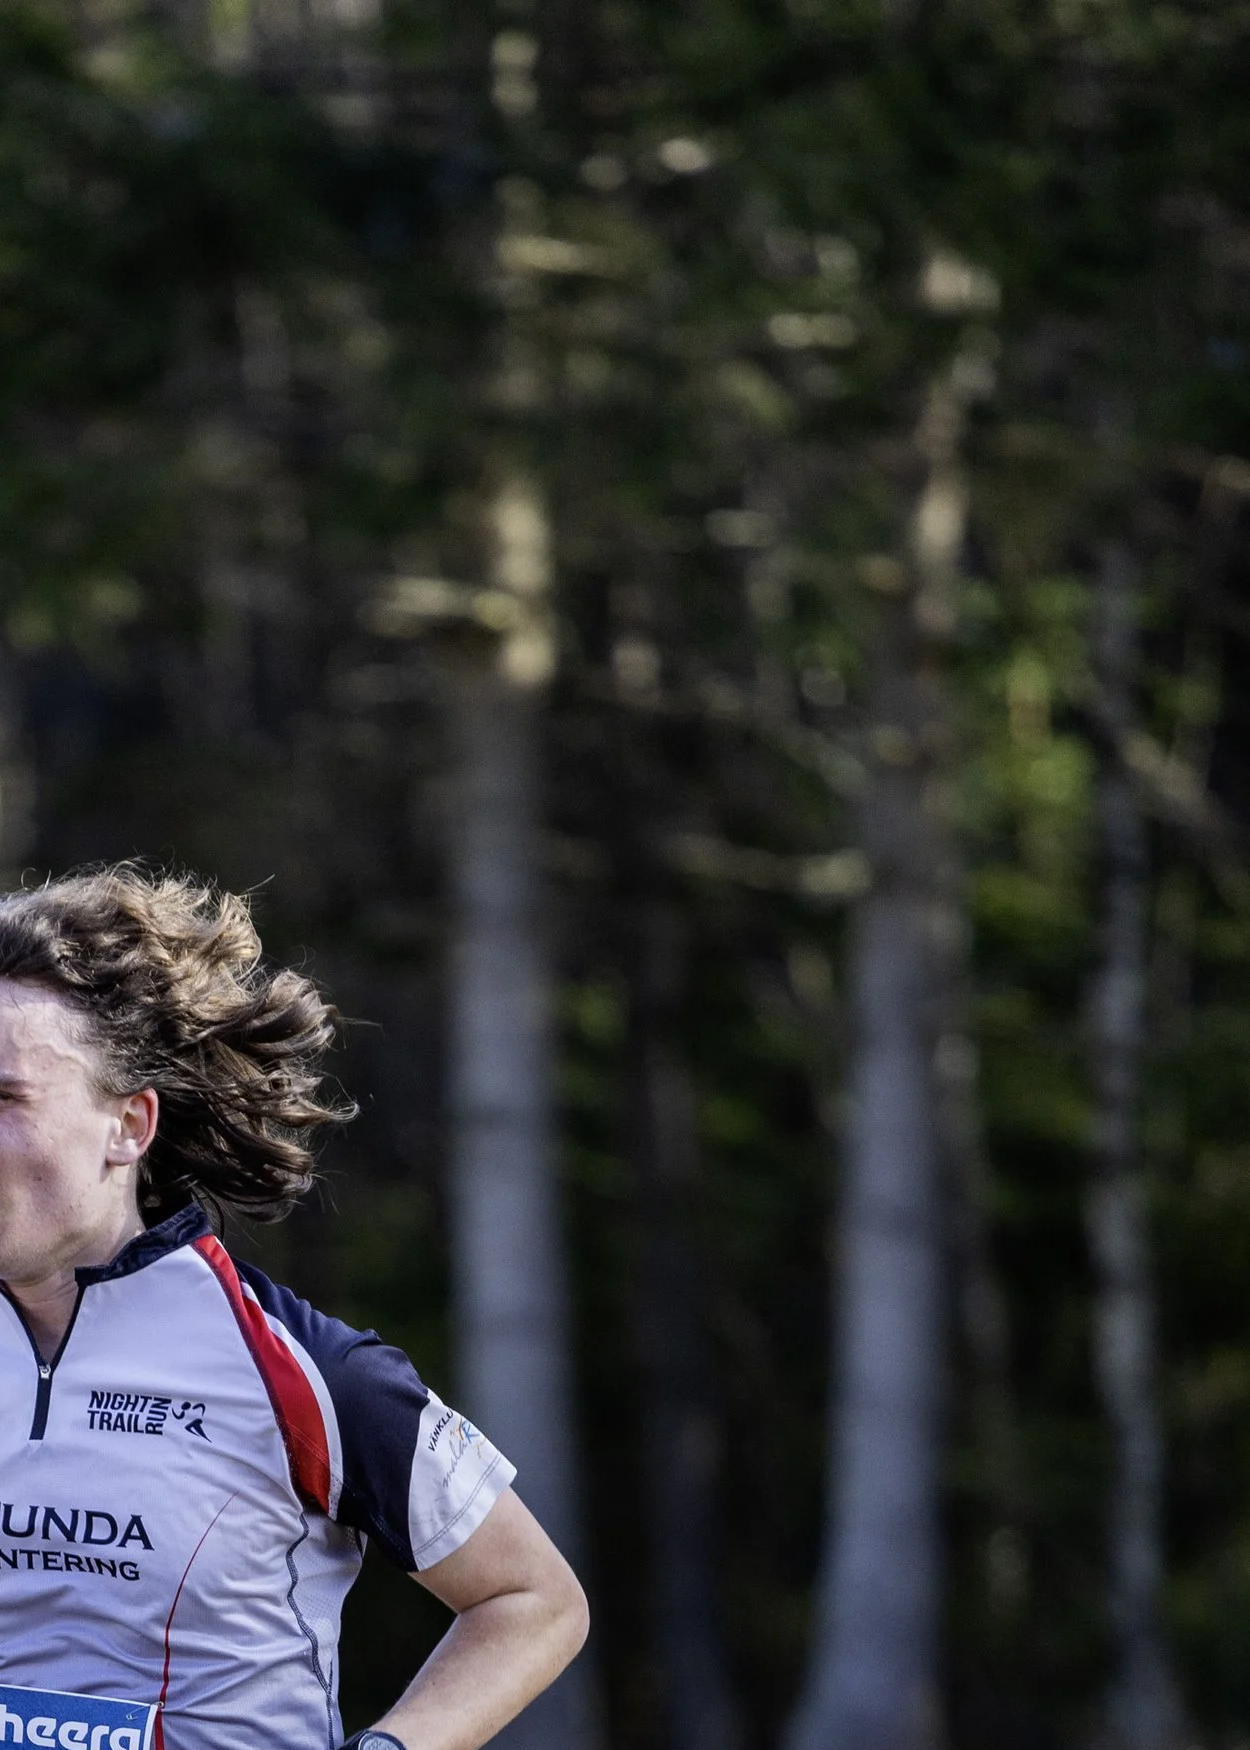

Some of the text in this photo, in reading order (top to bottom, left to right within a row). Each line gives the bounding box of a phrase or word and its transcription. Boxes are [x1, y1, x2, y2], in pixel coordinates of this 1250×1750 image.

[88, 1390, 152, 1413] NIGHT
[87, 1409, 145, 1434] TRAIL
[144, 1396, 172, 1436] RUN
